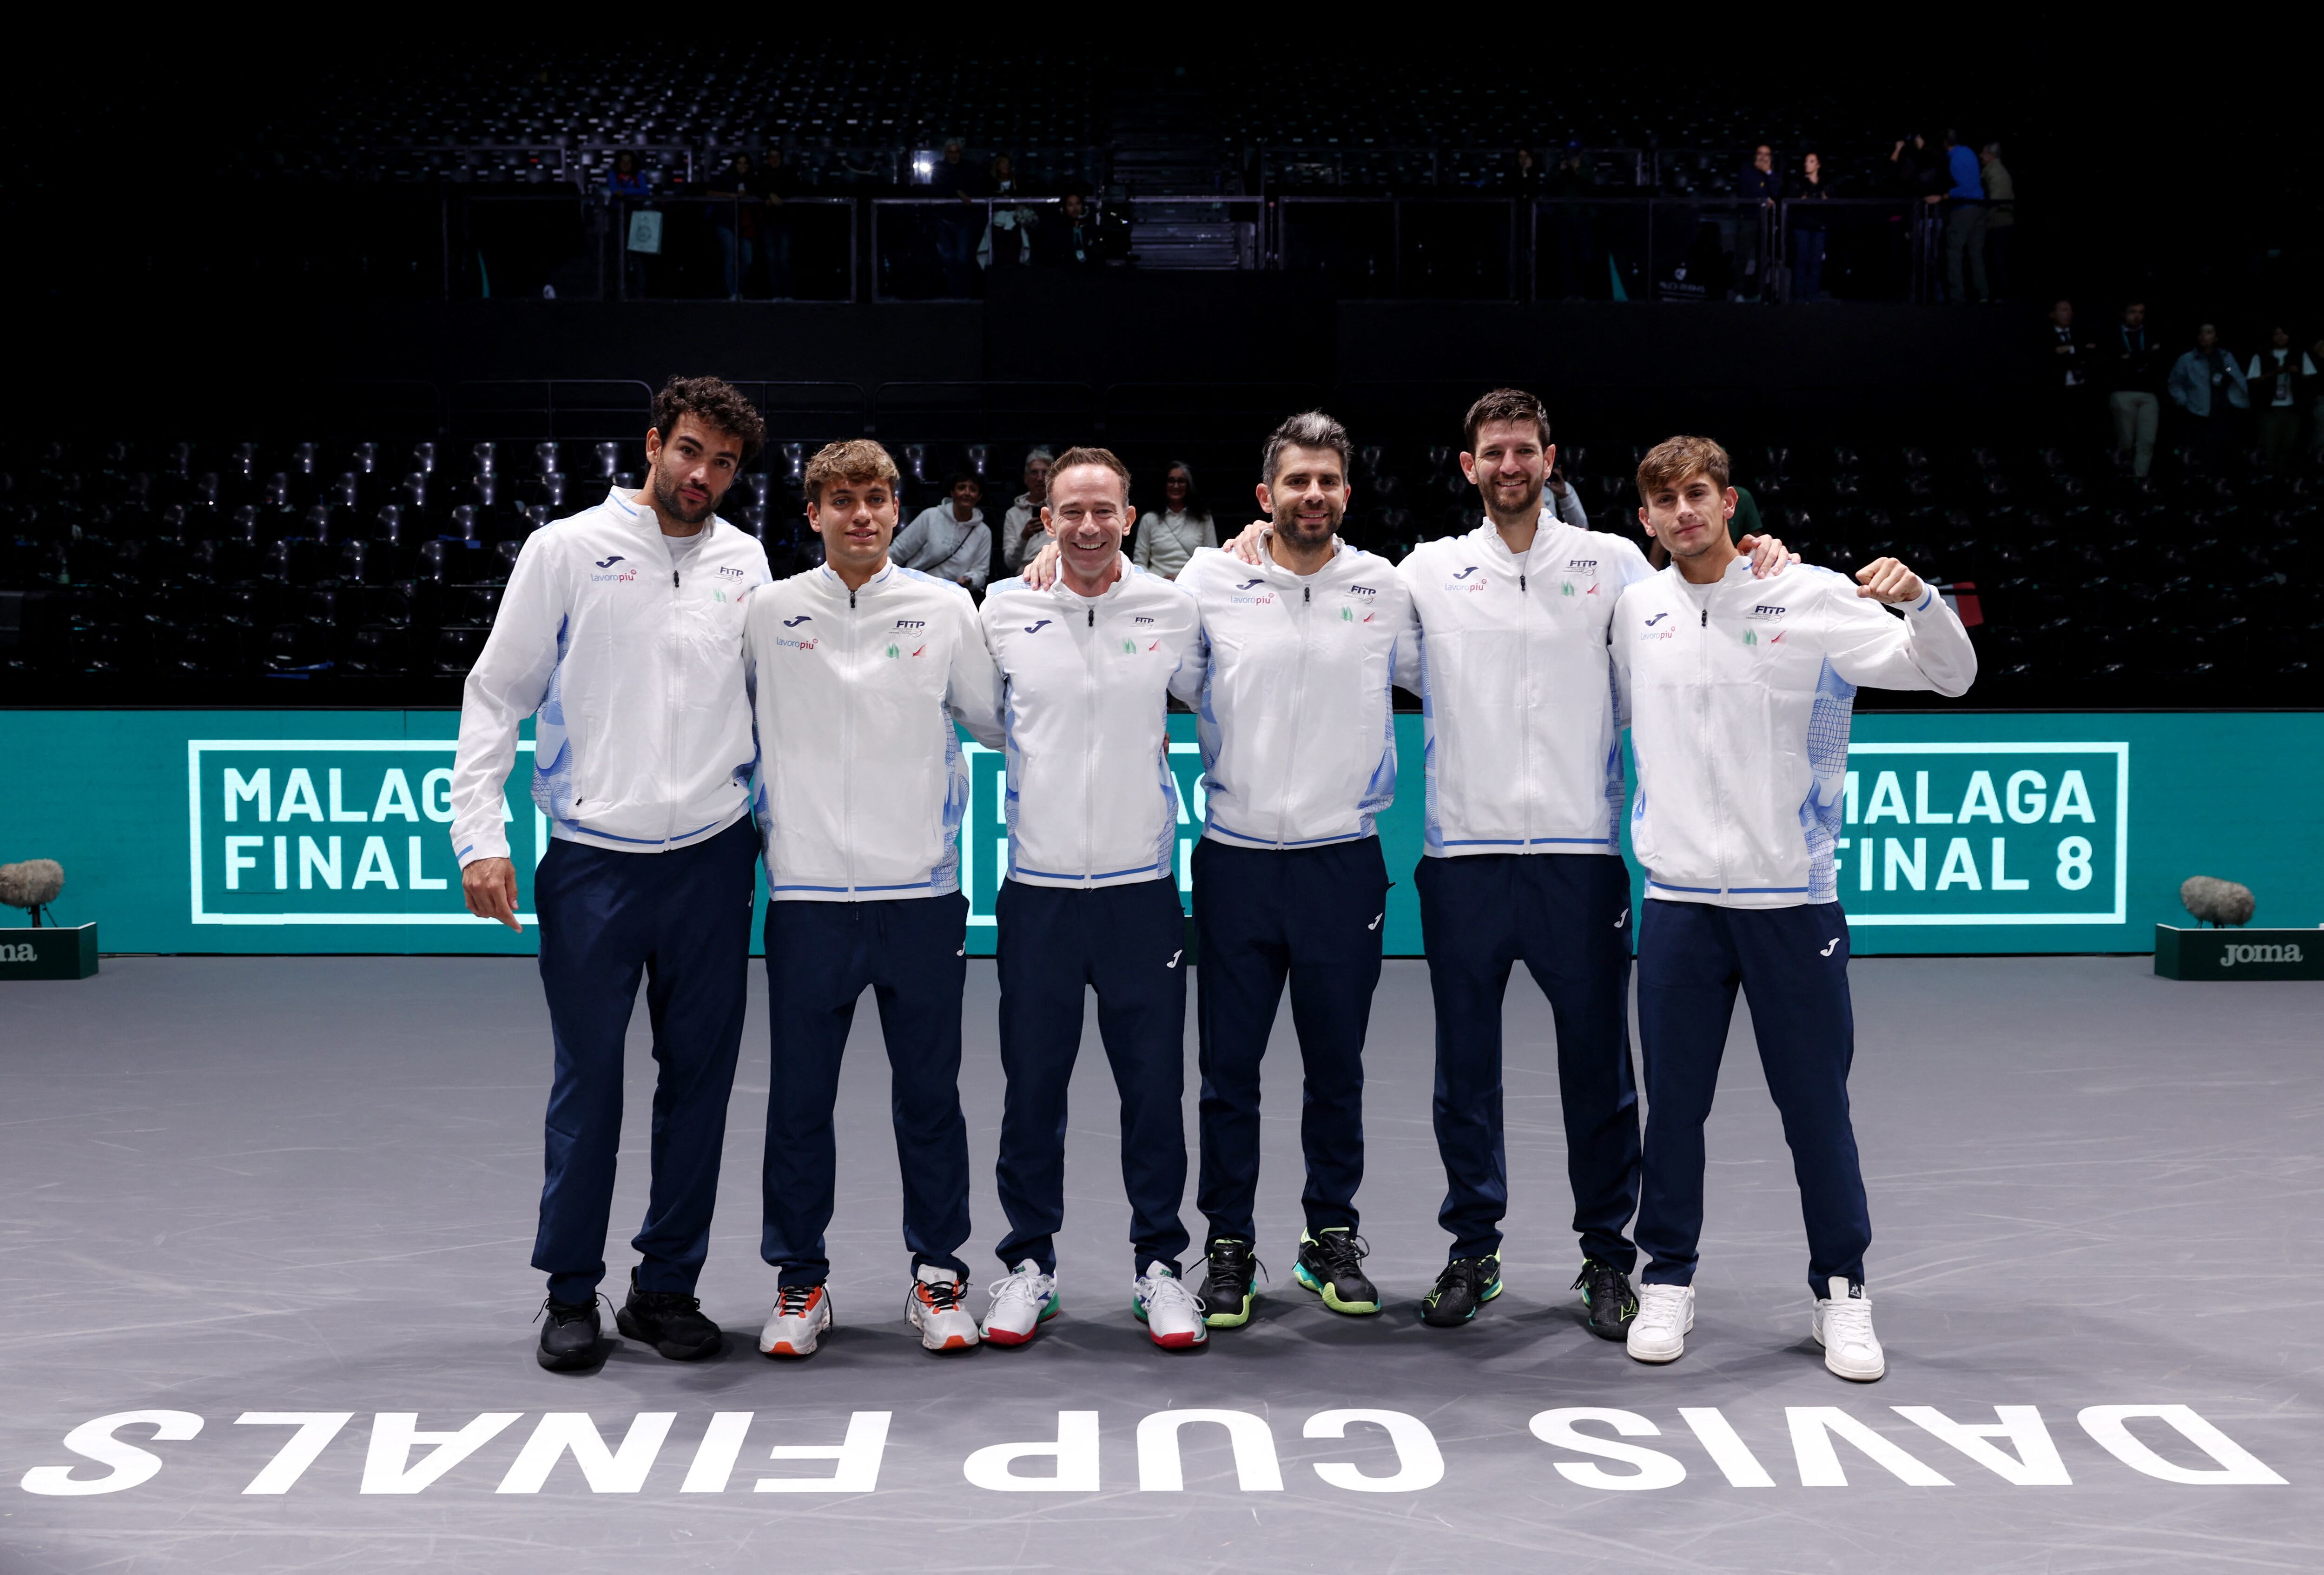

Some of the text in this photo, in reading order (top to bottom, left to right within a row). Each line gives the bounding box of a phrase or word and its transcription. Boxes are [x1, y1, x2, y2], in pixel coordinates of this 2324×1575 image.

[720, 566, 744, 576] FITP
[1350, 585, 1376, 596] FITP
[1755, 605, 1786, 615] FITP
[896, 620, 925, 629] FITP
[224, 768, 514, 822] MALAG
[225, 836, 447, 890] FINAL
[2056, 835, 2093, 891] 8
[2220, 944, 2304, 966] Joma
[20, 1404, 2290, 1496] DAVIS CUP FINALS
